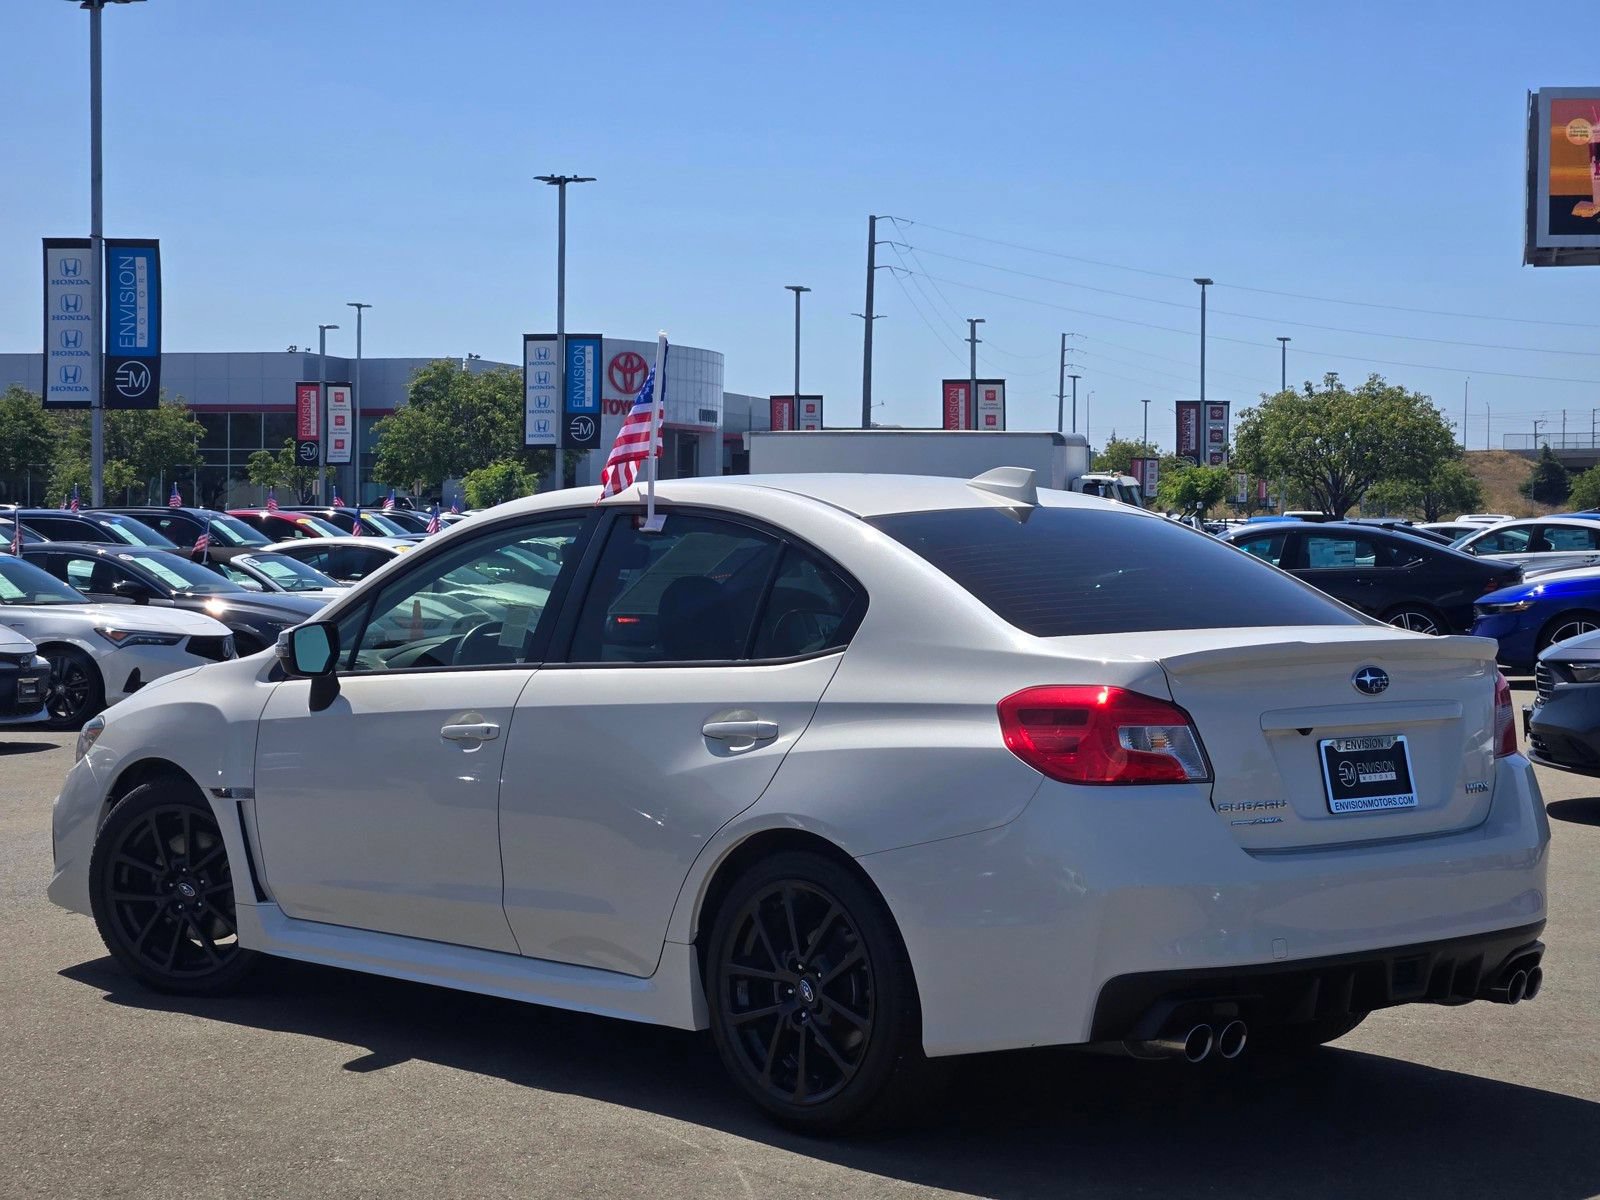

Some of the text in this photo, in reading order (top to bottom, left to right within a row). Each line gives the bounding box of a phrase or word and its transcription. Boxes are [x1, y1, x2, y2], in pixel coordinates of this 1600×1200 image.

[119, 256, 135, 348] ENVISION
[138, 264, 146, 340] MOTORS
[573, 345, 585, 408] ENVISION
[302, 390, 311, 436] ENVISION
[602, 399, 634, 415] TOY
[1345, 738, 1384, 750] ENVISION
[1356, 760, 1395, 774] ENVISION
[1218, 799, 1287, 812] SUBARU
[1334, 796, 1415, 811] ENVISIONMOTORS.COM
